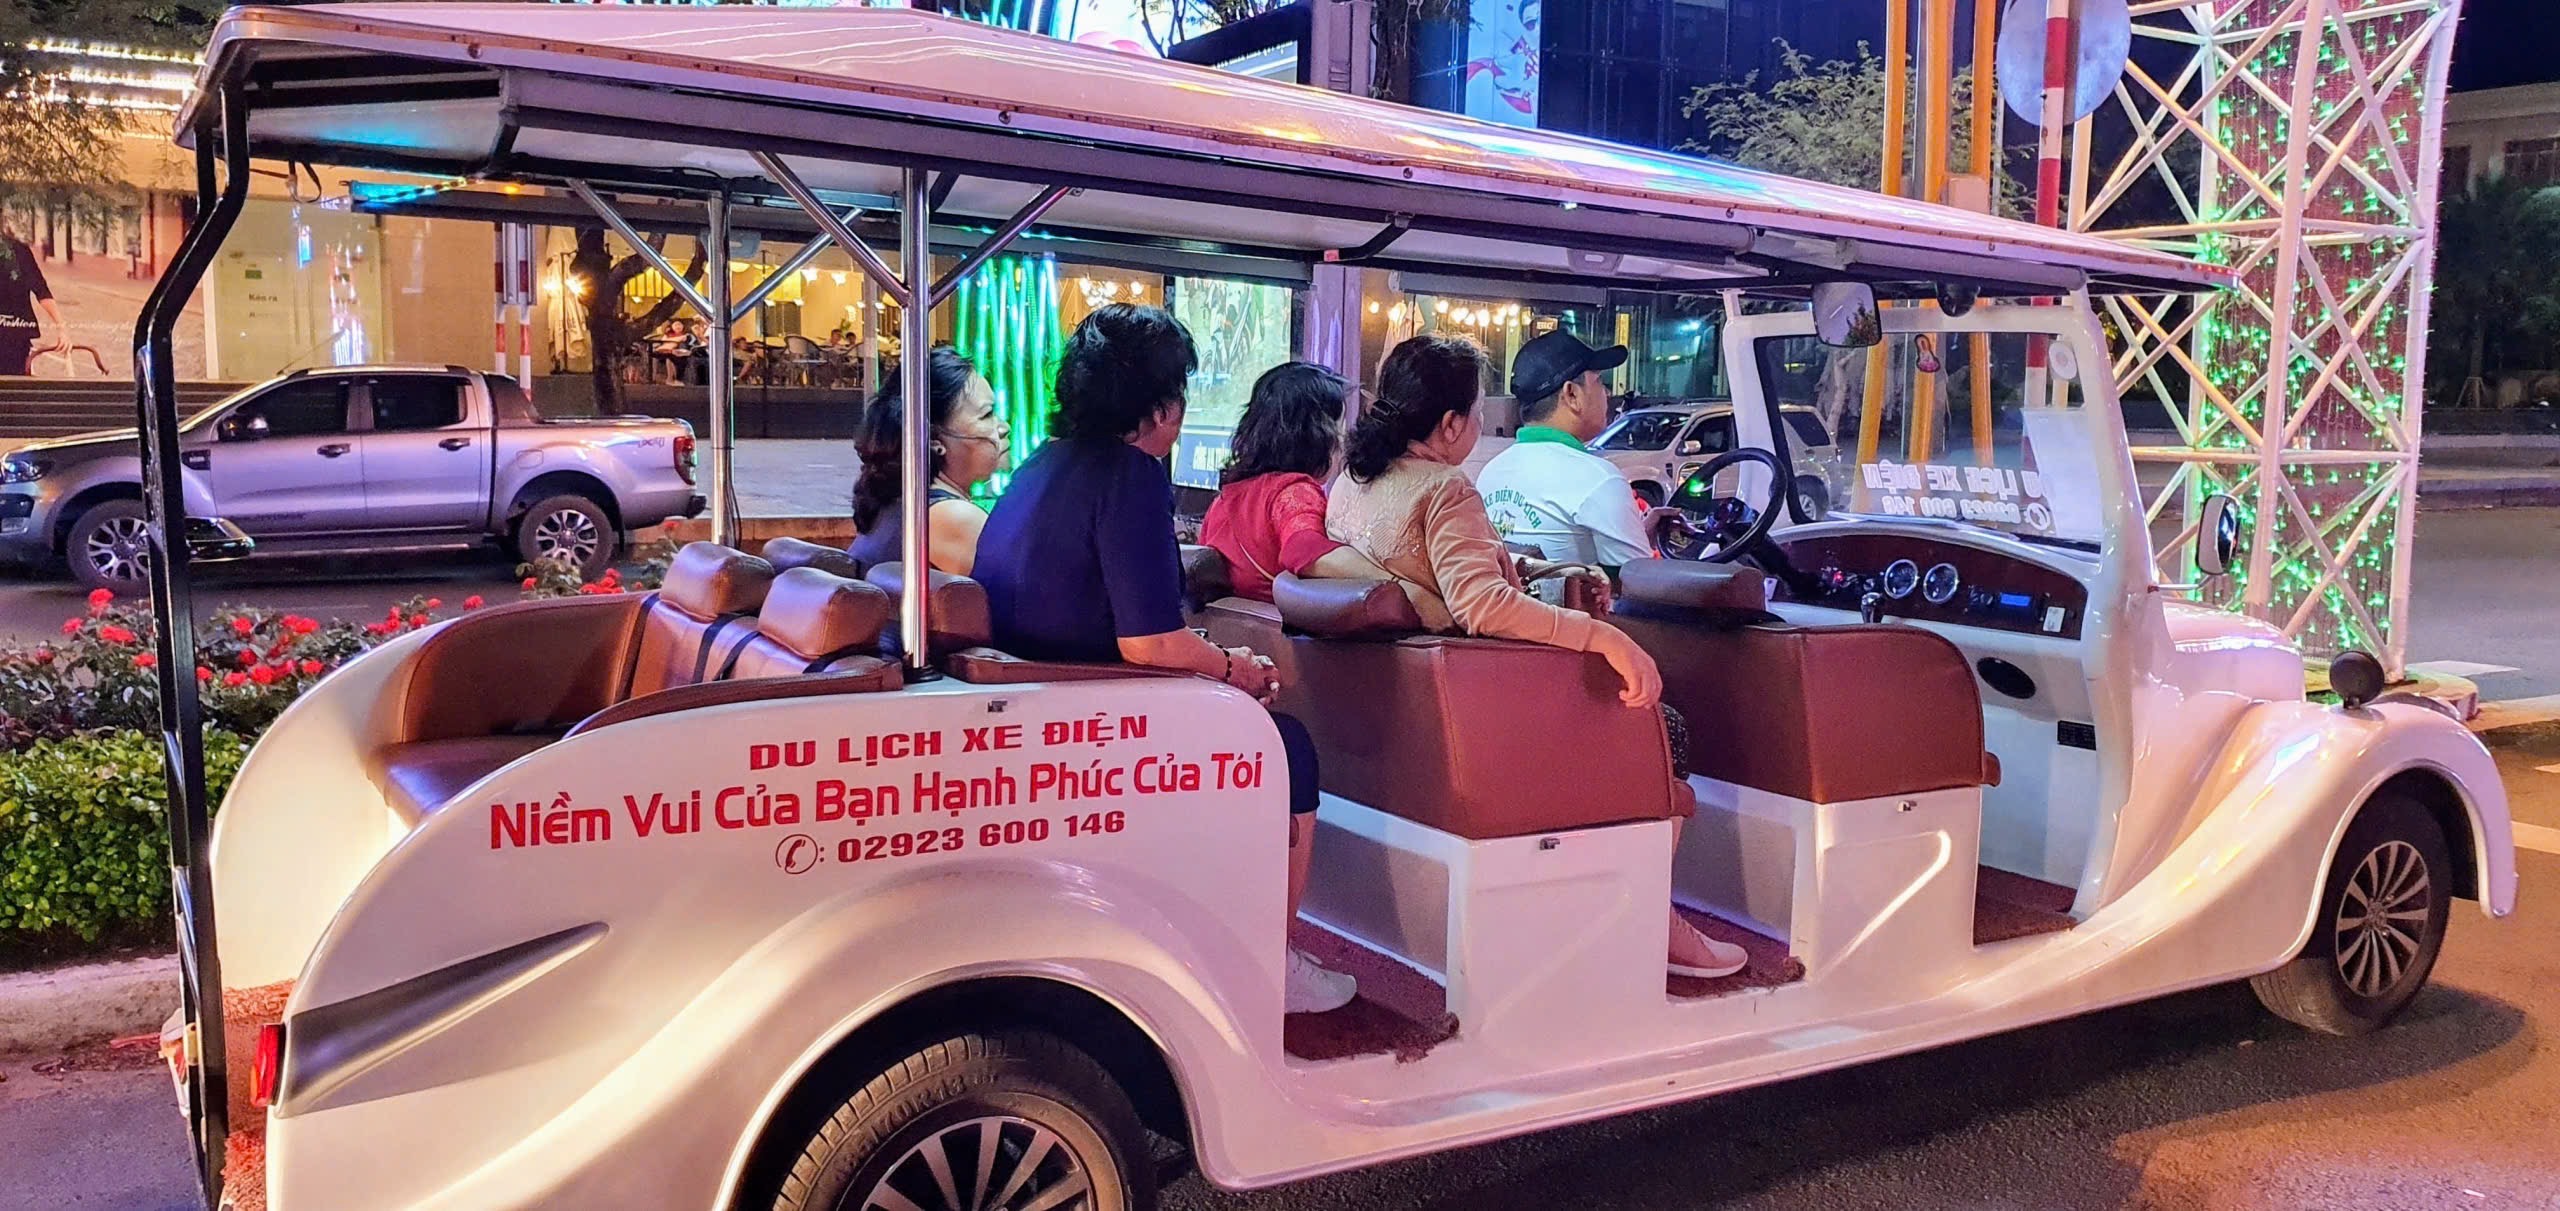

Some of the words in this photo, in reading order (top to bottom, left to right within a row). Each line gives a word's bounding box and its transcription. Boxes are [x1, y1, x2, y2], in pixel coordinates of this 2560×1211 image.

[750, 740, 817, 771] DU
[838, 731, 943, 768] LỊCH
[962, 725, 1022, 753] XE
[1042, 713, 1148, 748] ĐIỆN
[490, 791, 612, 850] Niềm
[624, 790, 702, 839] Vui
[715, 784, 802, 830] Của
[815, 779, 900, 827] Bạn
[913, 766, 1017, 818] Hạnh
[1029, 759, 1125, 804] Phúc
[1134, 753, 1202, 795] Của
[838, 827, 965, 864] 02923
[979, 818, 1050, 848] 600
[1064, 811, 1126, 839] 146
